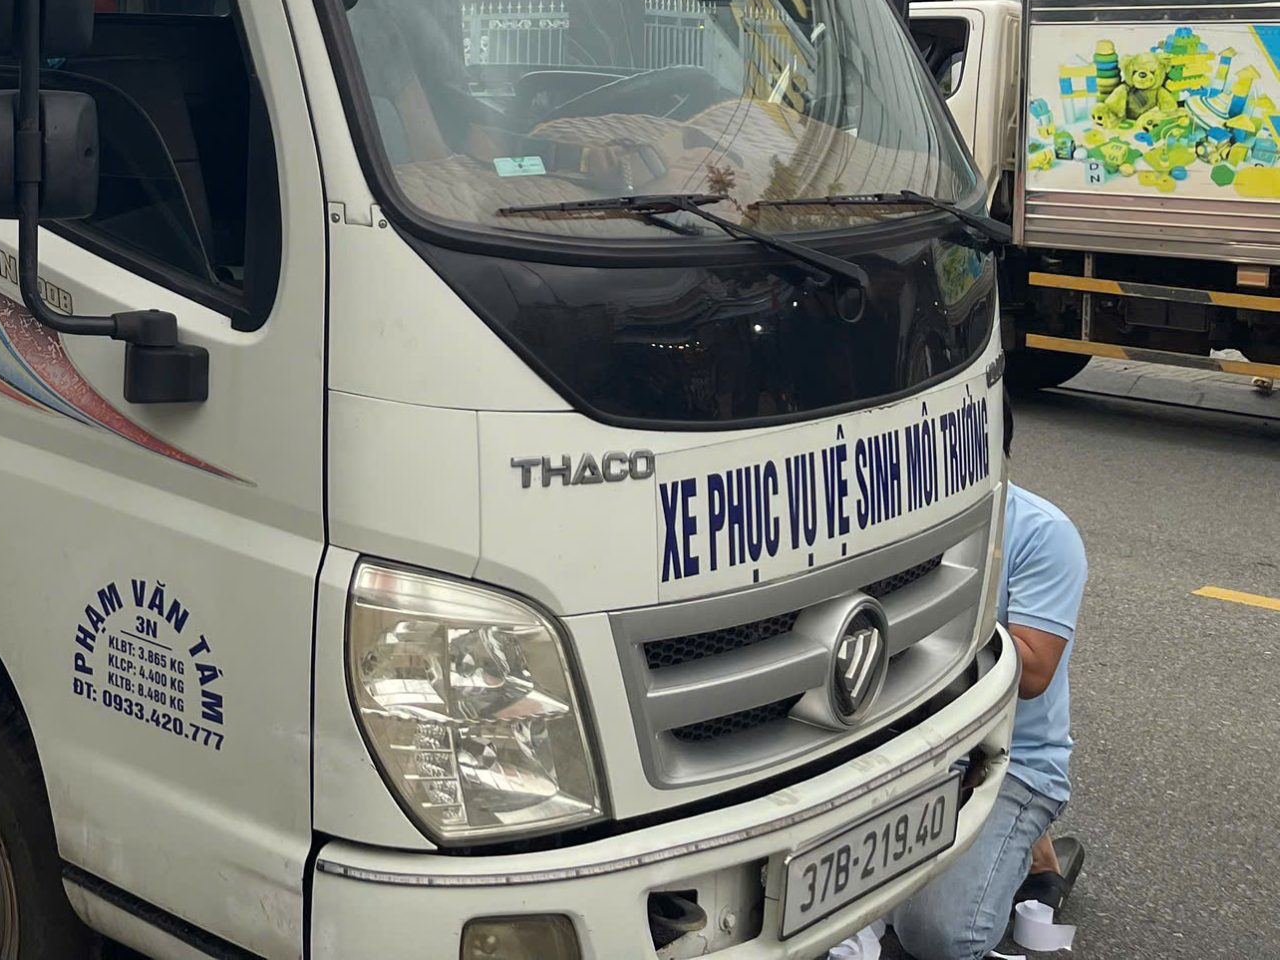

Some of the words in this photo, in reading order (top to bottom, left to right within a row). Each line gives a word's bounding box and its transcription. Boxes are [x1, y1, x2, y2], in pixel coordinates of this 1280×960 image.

[511, 448, 655, 489] THACO
[659, 477, 700, 583] XE
[707, 460, 780, 583] PHỤC
[785, 451, 818, 567] VỤ
[821, 424, 851, 556] VỆ
[855, 429, 902, 530] SINH
[905, 401, 939, 513] MÔI
[939, 384, 989, 498] TRƯỜNG
[135, 615, 158, 639] 3N
[74, 581, 124, 676] PHẠM
[131, 579, 190, 635] VĂN
[188, 634, 224, 726] TÁM
[108, 635, 136, 658] KLBT:
[138, 646, 168, 668] 3.865
[170, 657, 184, 676] KG
[108, 653, 137, 676] KLCP:
[138, 665, 168, 688] 4.400
[170, 676, 185, 694] KG
[108, 671, 136, 694] KLTB:
[170, 695, 185, 713] KG
[73, 677, 98, 702] ĐT:
[102, 689, 225, 751] 0933.420.777
[799, 794, 946, 914] 37B-219.40
